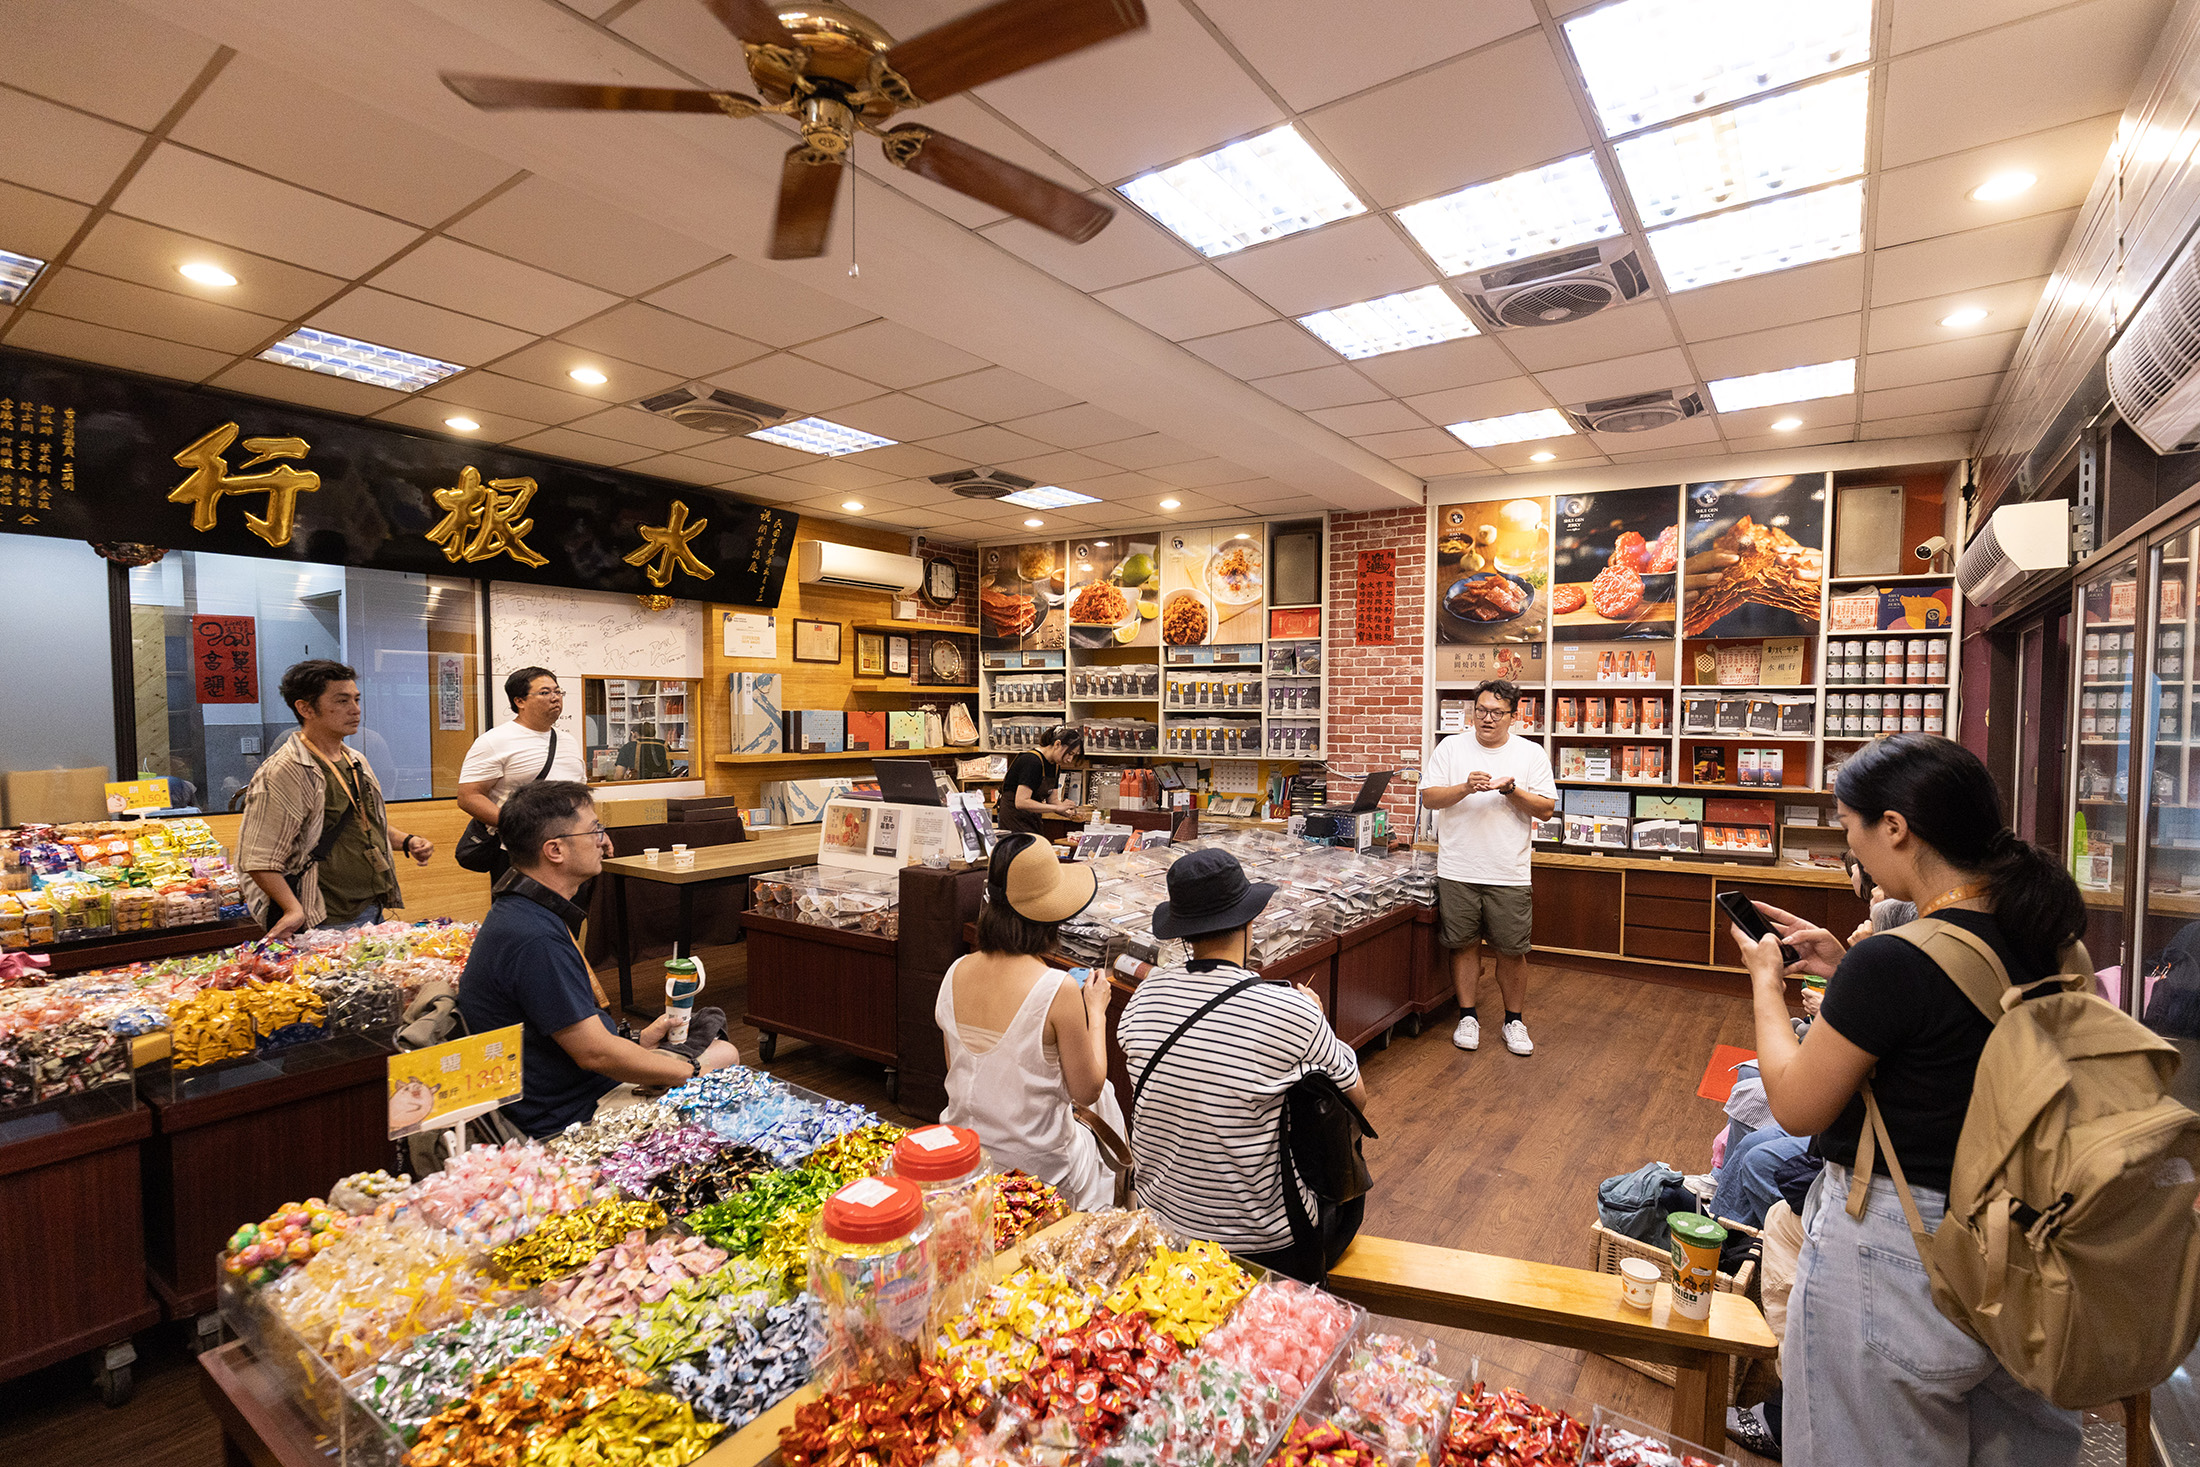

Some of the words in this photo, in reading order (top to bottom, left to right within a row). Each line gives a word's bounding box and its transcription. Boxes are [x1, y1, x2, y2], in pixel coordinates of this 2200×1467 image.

[1767, 663, 1795, 671] 水根行
[142, 793, 161, 802] 150
[882, 815, 893, 823] 好友
[440, 1041, 503, 1073] 糖果
[465, 1066, 504, 1091] 130
